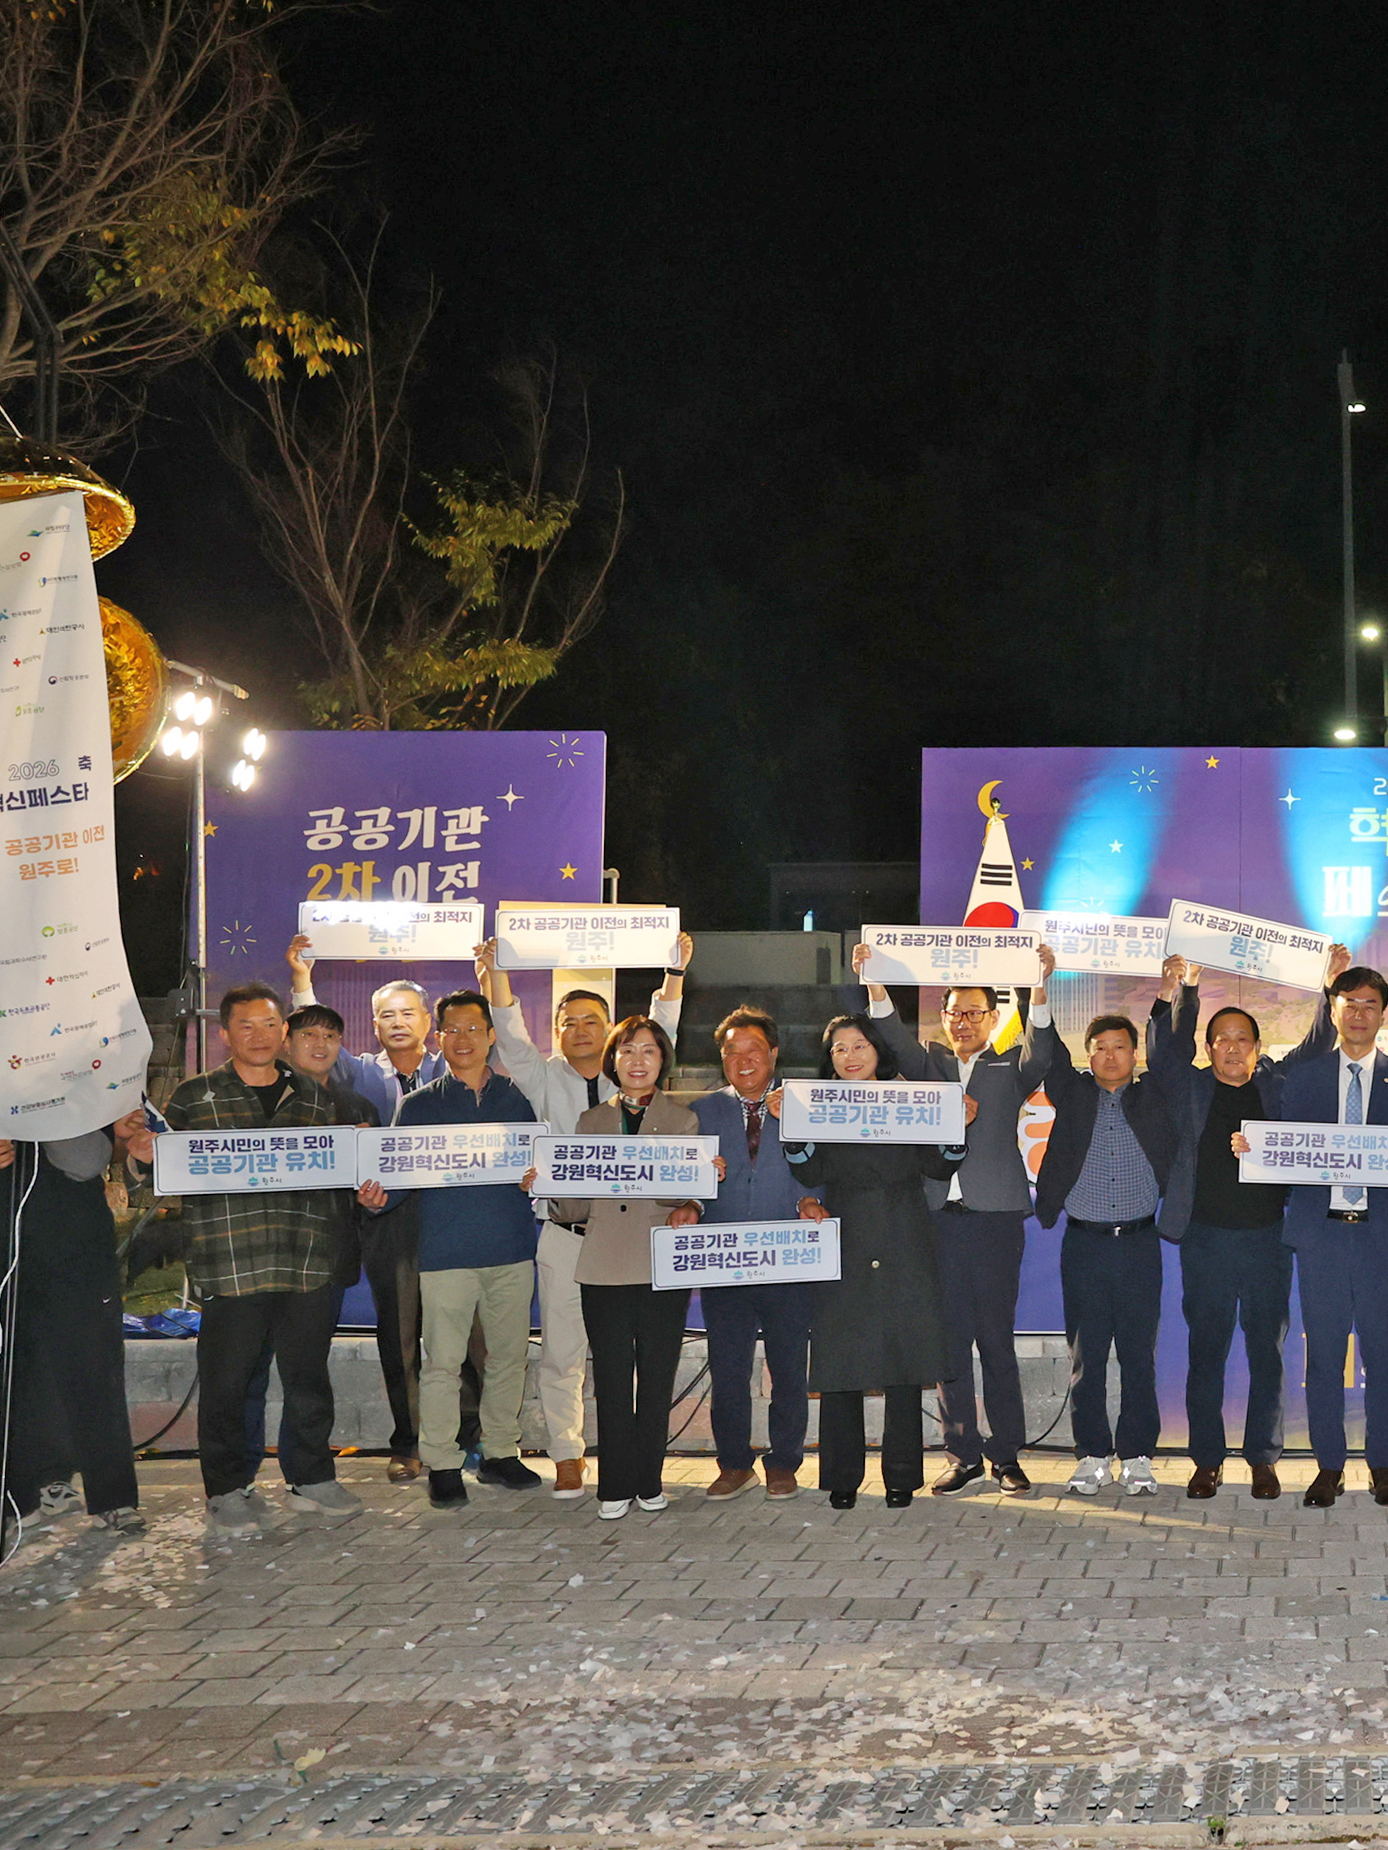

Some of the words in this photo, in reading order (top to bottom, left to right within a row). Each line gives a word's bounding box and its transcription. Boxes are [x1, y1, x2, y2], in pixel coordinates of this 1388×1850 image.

[8, 759, 60, 781] 2026
[78, 755, 92, 771] 축
[303, 805, 490, 852] 공공기관
[5, 831, 78, 856] 공공기관
[82, 825, 105, 844] 이전
[19, 857, 79, 880] 원주로!
[306, 860, 382, 901] 2차
[392, 860, 481, 903] 이전
[434, 911, 472, 923] 최적지
[509, 918, 531, 930] 2차
[534, 917, 588, 930] 공공기관
[591, 917, 627, 930] 이전의
[631, 916, 670, 929] 최적지
[566, 931, 614, 951] 원주!
[876, 933, 897, 946] 2차
[900, 933, 952, 947] 공공기관
[955, 935, 991, 948] 이전의
[994, 935, 1033, 949] 최적지
[1113, 924, 1138, 938] 뜻을
[1183, 910, 1204, 926] 2차
[1206, 915, 1254, 937] 공공기관
[1256, 928, 1287, 945] 이전의
[1289, 935, 1324, 954] 최적지
[930, 949, 978, 969] 원주!
[1229, 935, 1274, 963] 원주!
[810, 1088, 878, 1103] 원주시민의
[883, 1090, 909, 1104] 뜻을
[913, 1091, 941, 1105] 모아
[808, 1105, 889, 1124] 공공기관
[895, 1106, 941, 1126] 유치!
[188, 1138, 265, 1154] 원주시민의
[270, 1136, 299, 1151] 뜻을
[303, 1135, 335, 1150] 모아
[381, 1135, 447, 1152] 공공기관
[453, 1132, 530, 1149] 우선배치로
[1264, 1131, 1326, 1148] 공공기관
[188, 1153, 278, 1175] 공공기관
[285, 1150, 335, 1171] 유치!
[378, 1152, 486, 1173] 강원혁신도시
[492, 1150, 531, 1168] 완성!
[554, 1145, 617, 1160] 공공기관
[622, 1145, 698, 1161] 우선배치로
[1262, 1150, 1362, 1170] 강원혁신도시
[551, 1164, 653, 1181] 강원혁신도시
[659, 1165, 699, 1182] 완성!
[674, 1232, 739, 1251] 공공기관
[744, 1230, 820, 1247] 우선배치로
[672, 1250, 776, 1272] 강원혁신도시
[781, 1247, 822, 1266] 완성!
